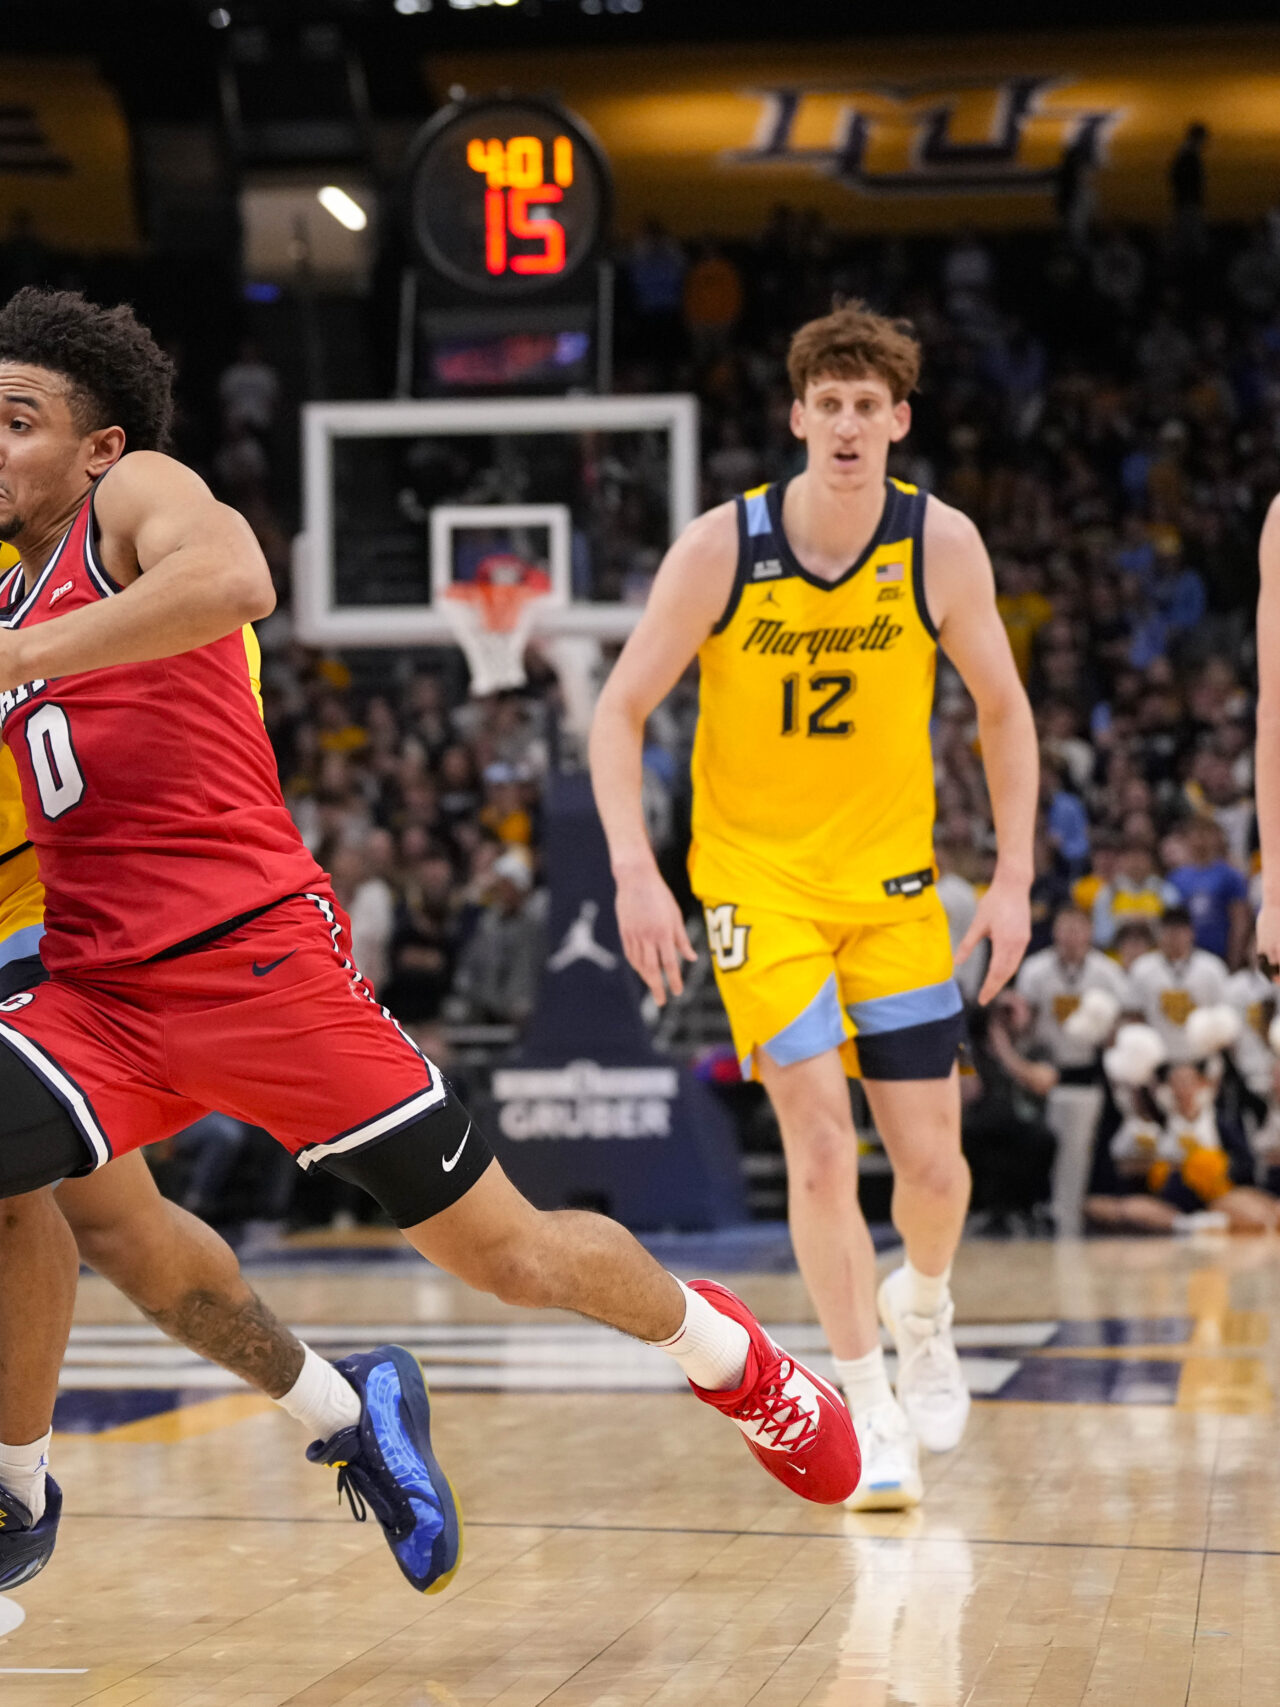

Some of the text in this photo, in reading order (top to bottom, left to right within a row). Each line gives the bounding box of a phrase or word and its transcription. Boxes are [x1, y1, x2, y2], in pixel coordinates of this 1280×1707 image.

[485, 183, 566, 275] 15
[742, 613, 904, 666] Marquette
[780, 669, 858, 740] 12
[24, 701, 87, 822] 0
